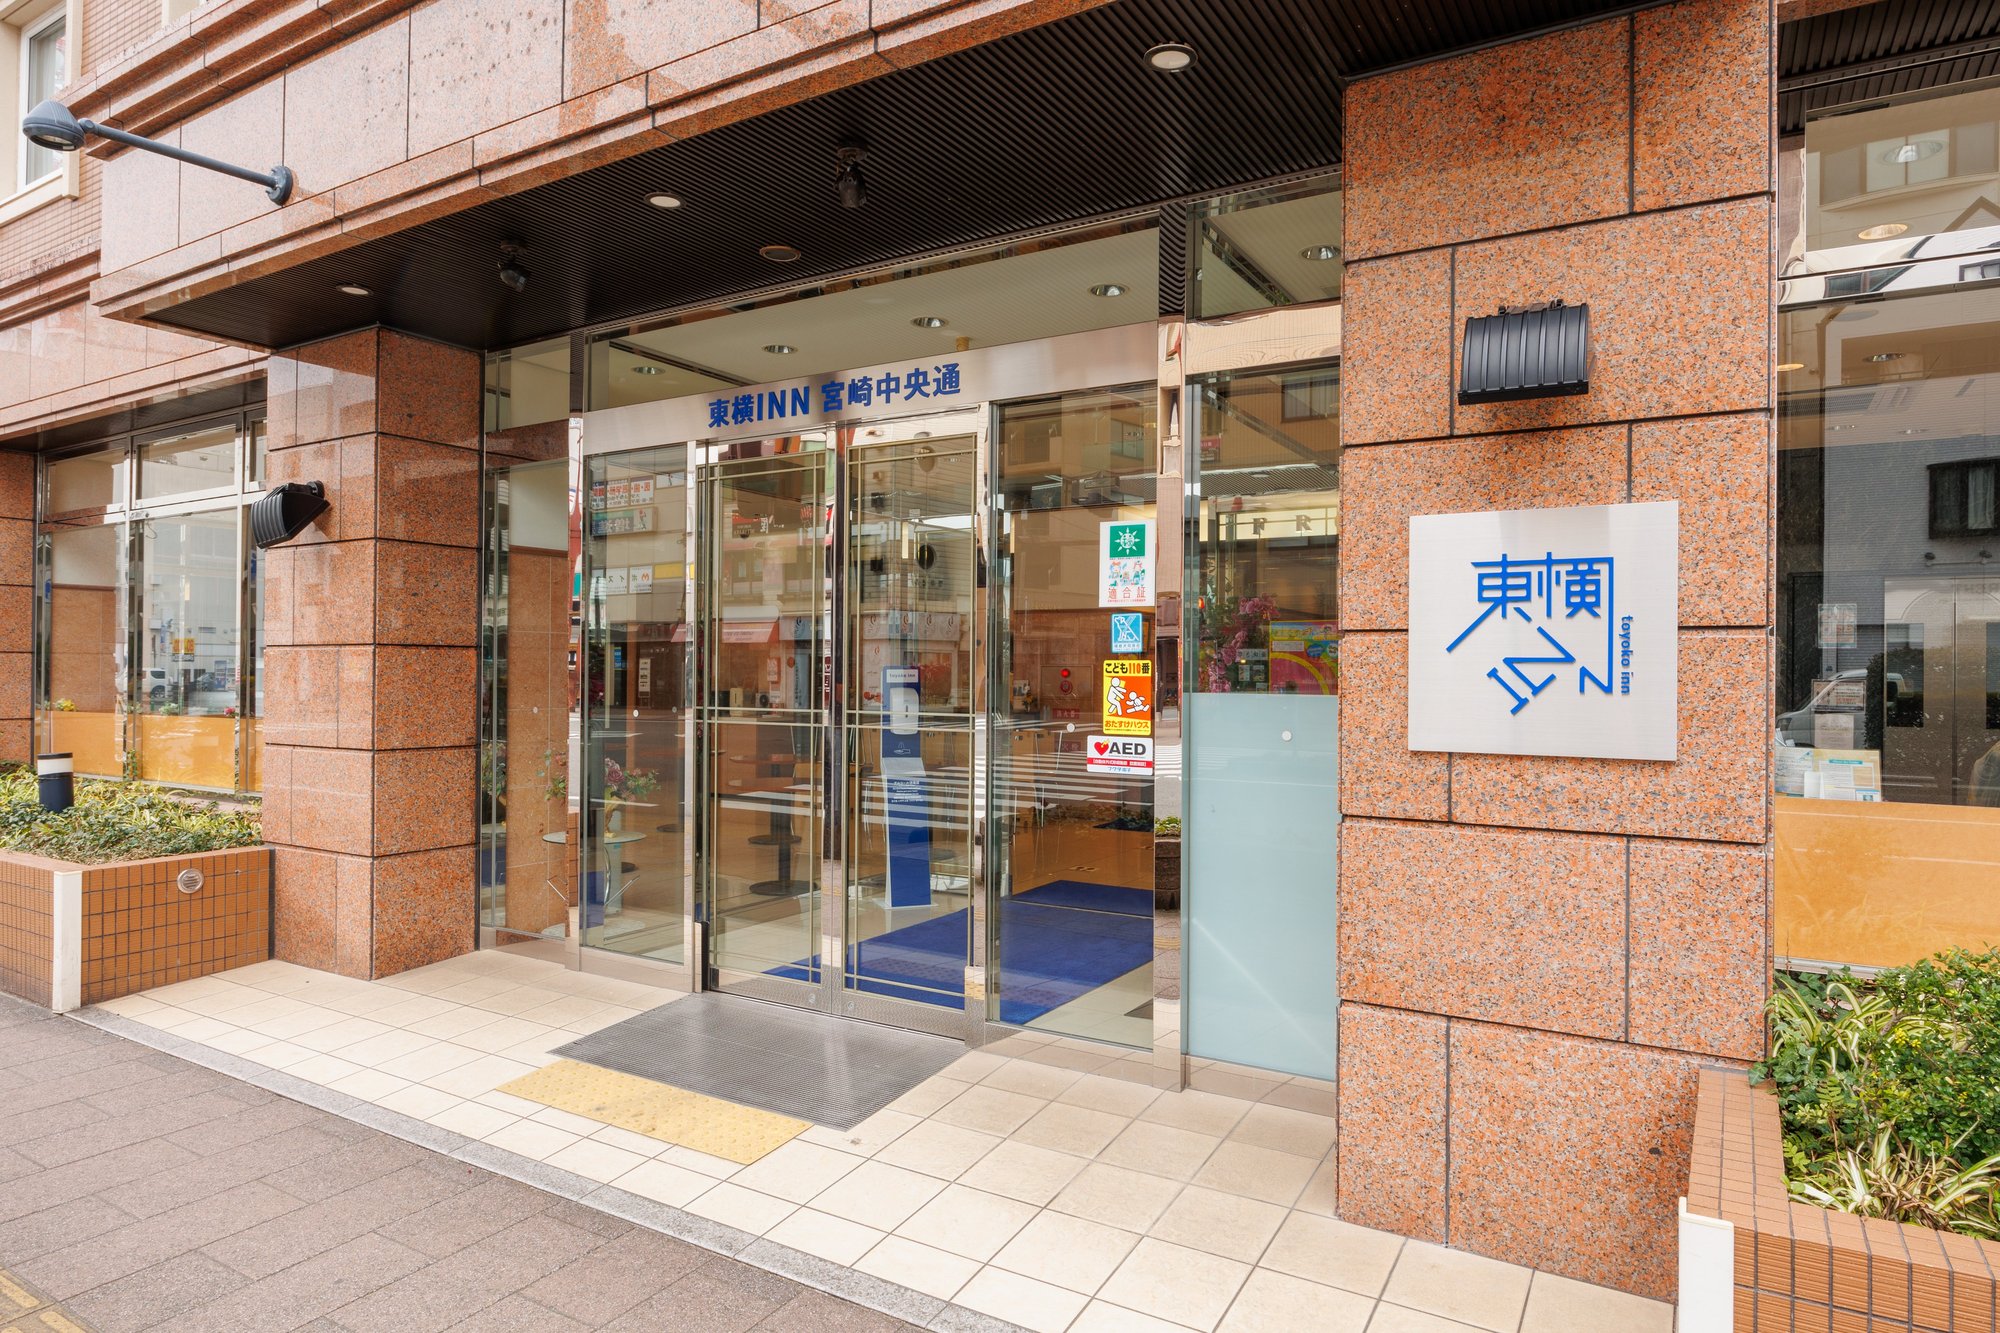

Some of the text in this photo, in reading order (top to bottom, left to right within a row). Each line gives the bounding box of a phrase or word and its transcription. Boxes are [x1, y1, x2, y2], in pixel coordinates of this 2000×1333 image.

[707, 362, 961, 428] 東横INN 宮崎中央通
[1108, 586, 1147, 599] 適合証
[1618, 615, 1635, 696] toyoko inn
[1105, 662, 1150, 674] こども110番
[1105, 720, 1150, 729] おたすけハウス
[1109, 741, 1147, 756] AED
